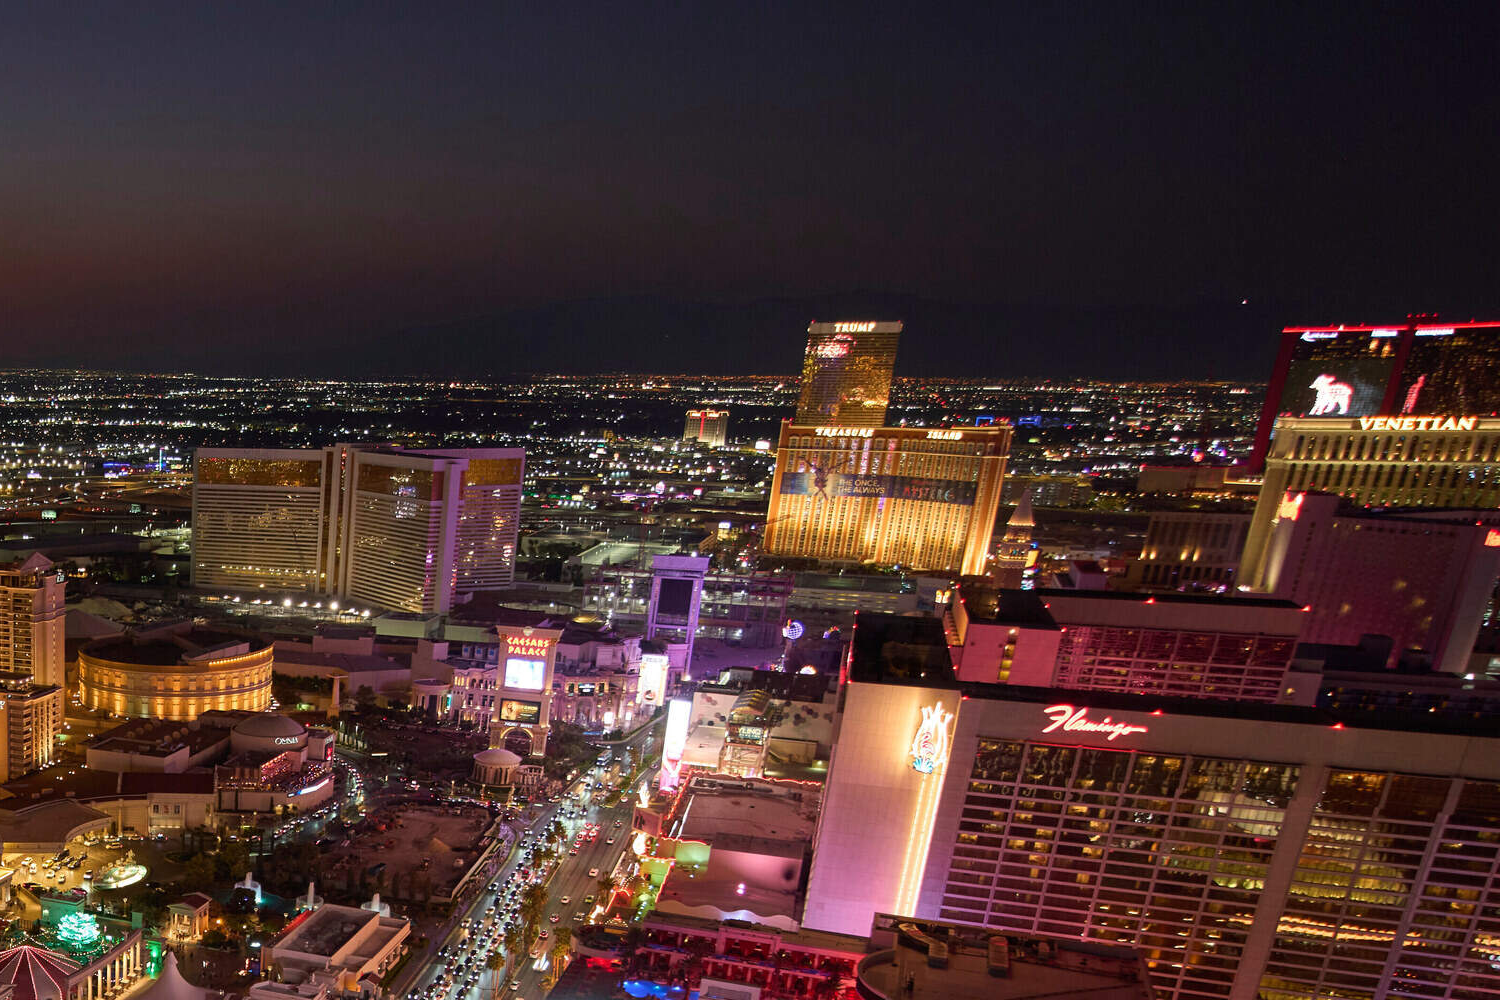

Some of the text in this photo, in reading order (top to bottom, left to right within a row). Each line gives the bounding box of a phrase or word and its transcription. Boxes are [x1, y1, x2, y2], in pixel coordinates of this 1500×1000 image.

[834, 321, 876, 332] TRUMP
[1359, 416, 1478, 431] VENETIAN
[815, 428, 963, 440] TREASURE ISLAND
[507, 636, 549, 648] CAESARS
[508, 646, 547, 656] PALACE
[1042, 704, 1148, 740] Flamingo
